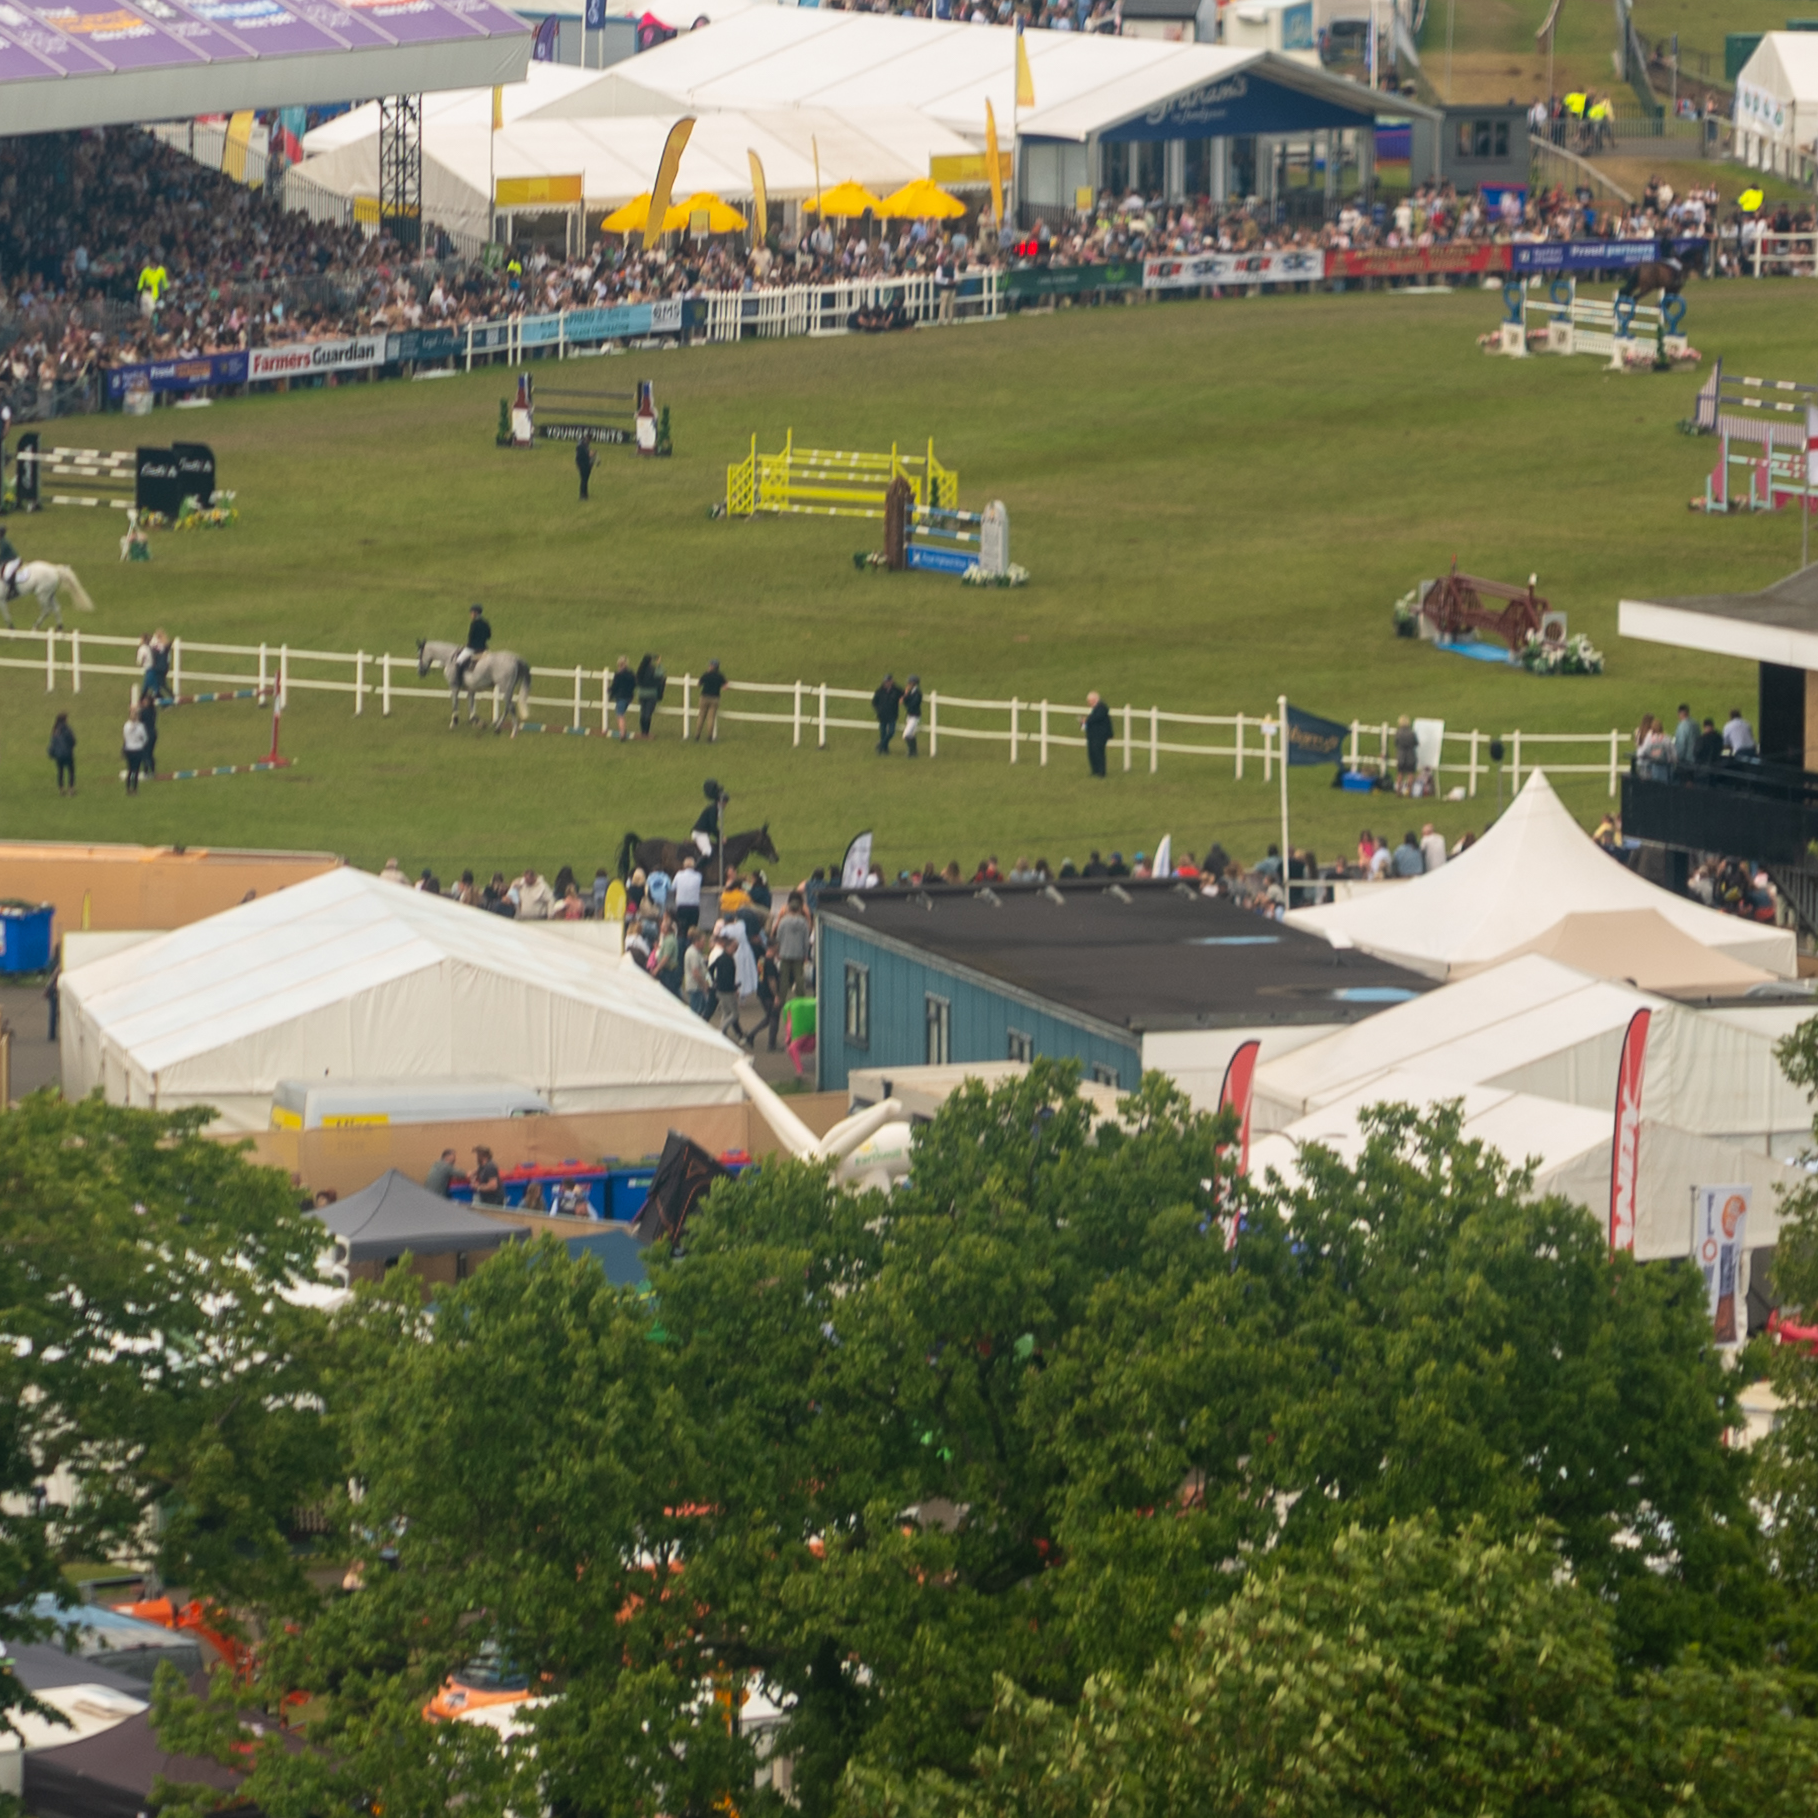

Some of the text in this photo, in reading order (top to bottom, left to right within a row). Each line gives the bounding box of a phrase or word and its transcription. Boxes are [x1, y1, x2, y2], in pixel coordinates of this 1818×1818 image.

[1570, 244, 1605, 257] Proud
[1606, 243, 1658, 259] partners
[253, 342, 375, 374] Farmers Guardian
